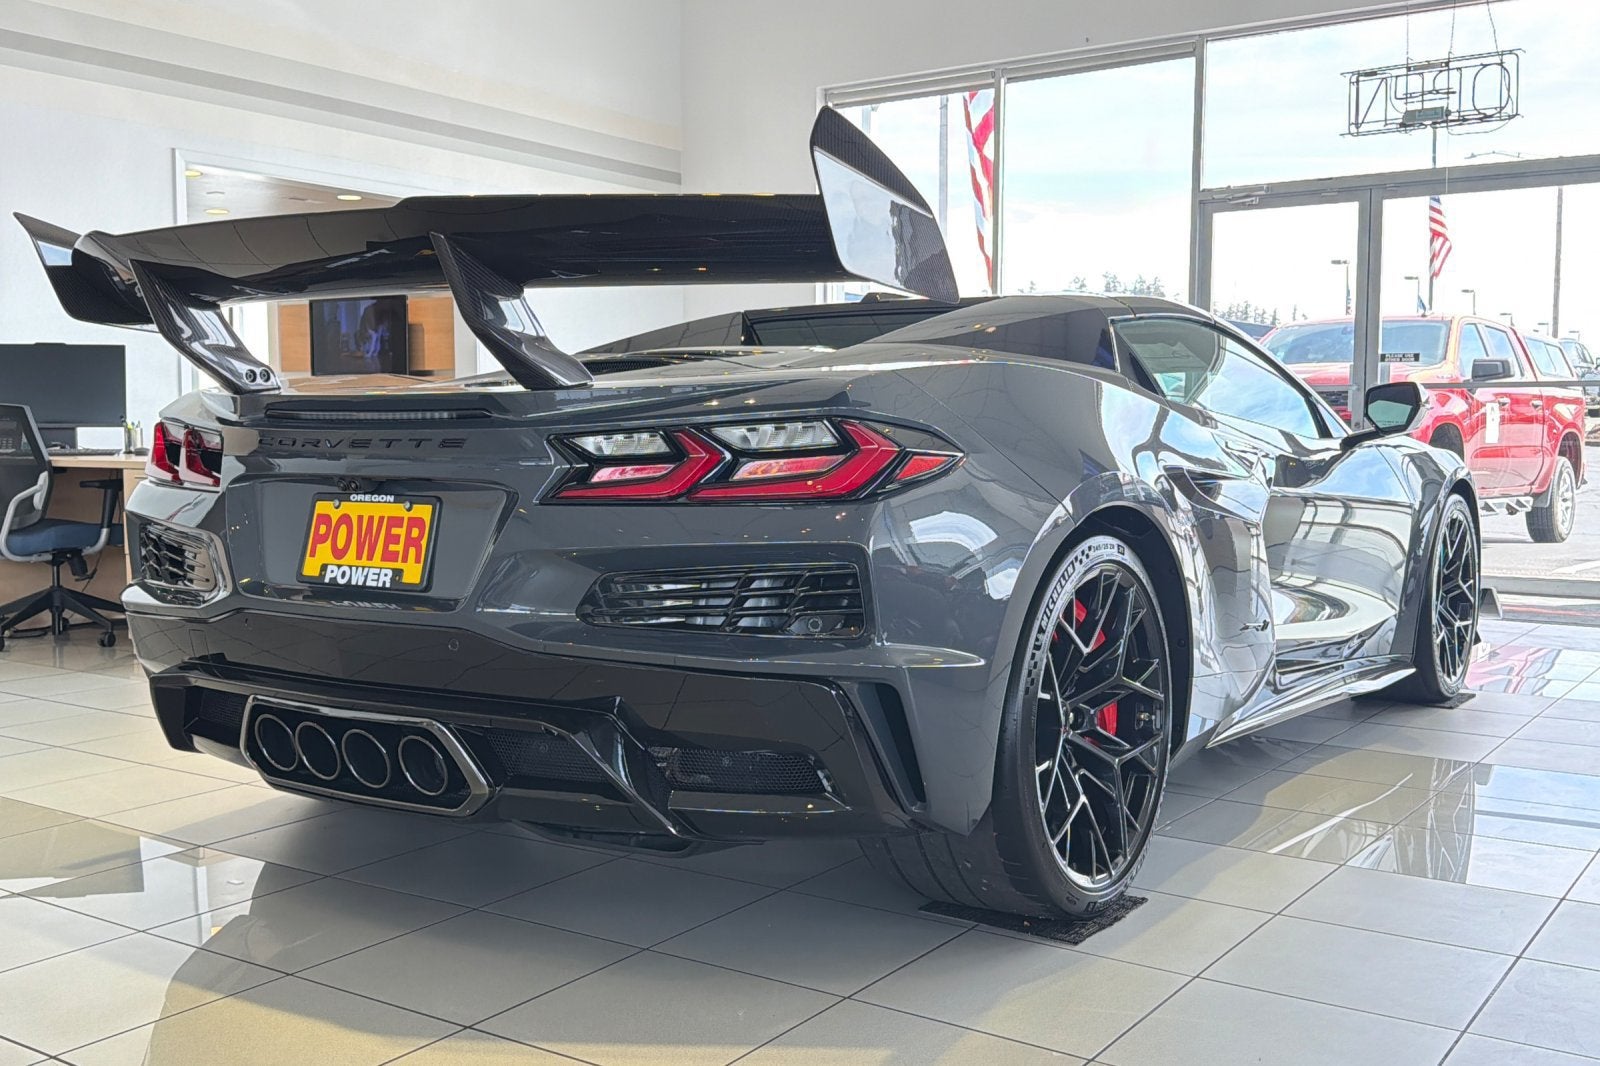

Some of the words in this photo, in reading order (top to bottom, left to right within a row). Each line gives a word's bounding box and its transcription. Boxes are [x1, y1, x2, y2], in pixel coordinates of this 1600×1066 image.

[258, 435, 467, 449] CORVETTE
[350, 494, 395, 502] OREGON
[309, 514, 426, 563] POWER
[324, 566, 392, 588] POWER
[1040, 562, 1075, 629] MICHELIN
